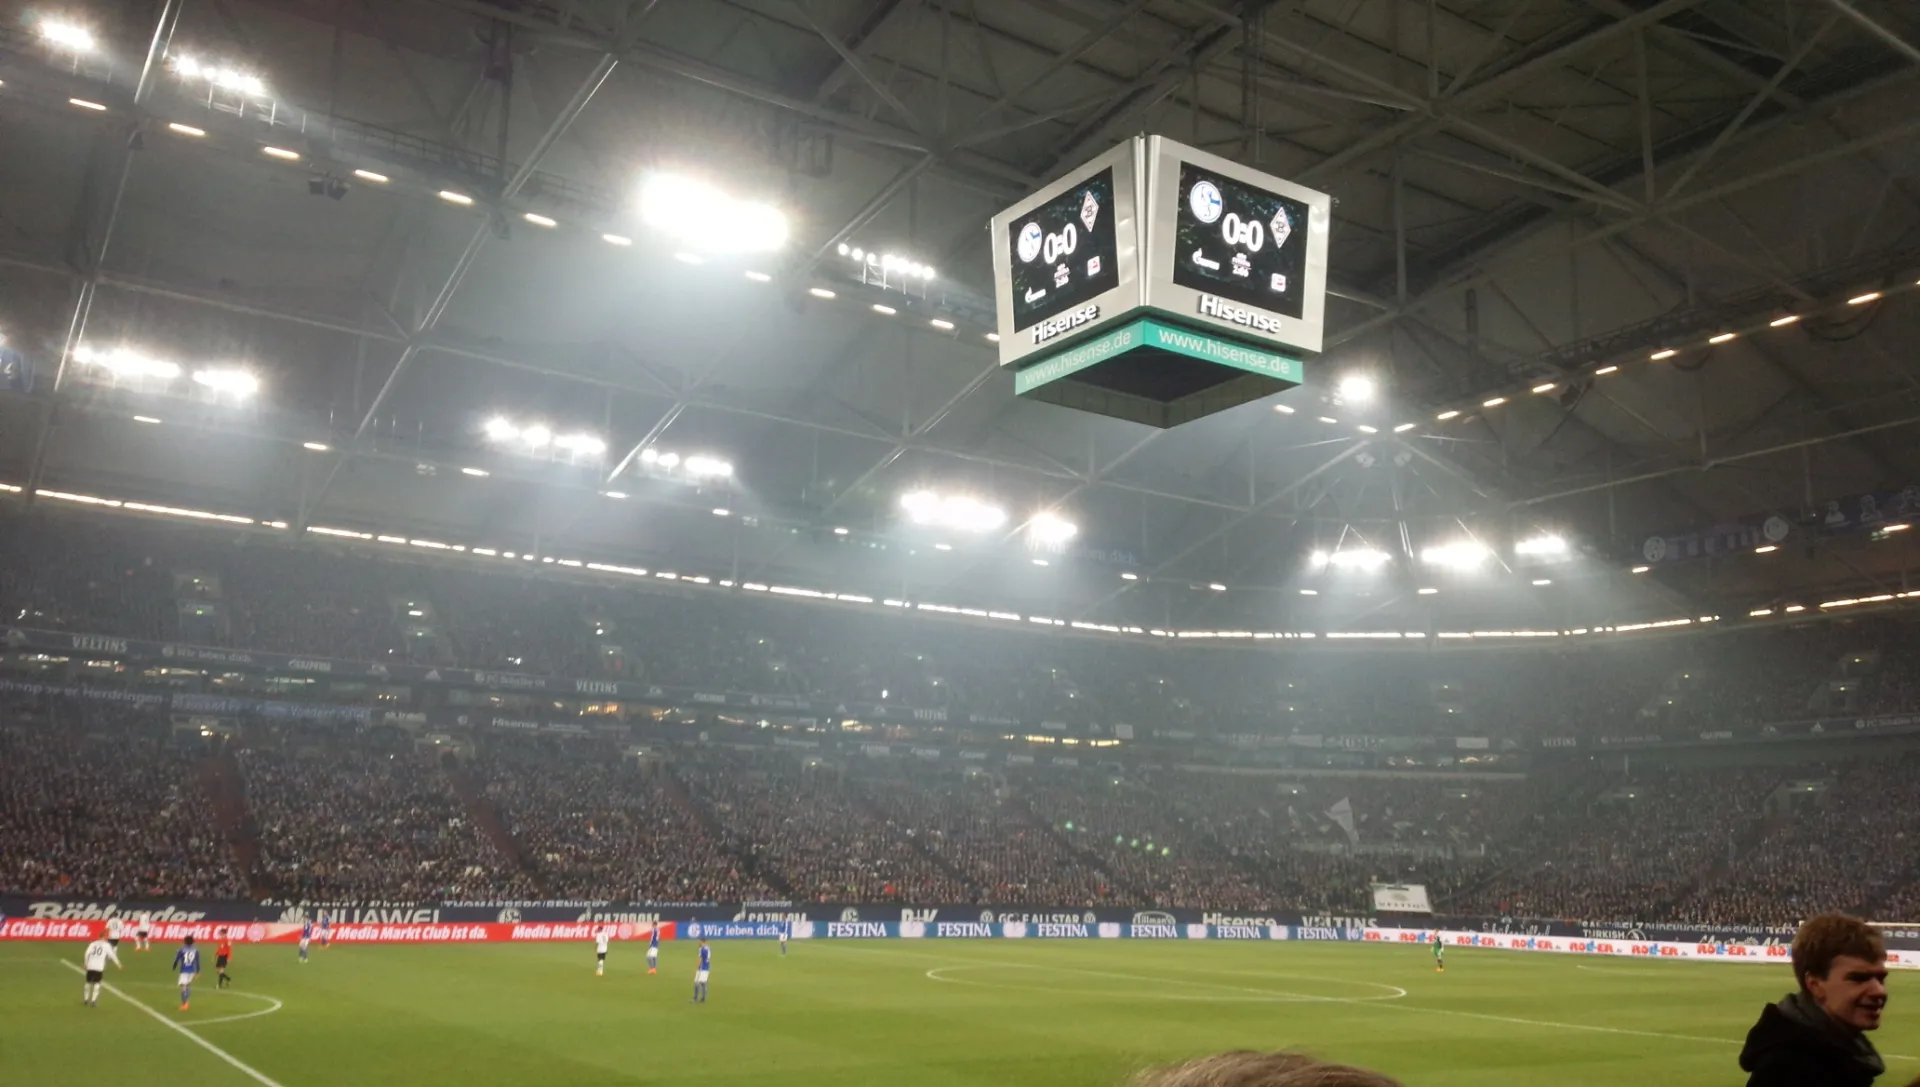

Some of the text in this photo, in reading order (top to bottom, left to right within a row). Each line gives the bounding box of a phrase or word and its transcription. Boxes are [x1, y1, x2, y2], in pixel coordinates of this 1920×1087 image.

[1222, 213, 1264, 252] 0:0
[1044, 223, 1077, 264] 0:0
[1200, 294, 1282, 333] Hisense
[1031, 304, 1098, 344] Hisense
[1025, 332, 1132, 385] www.hisense.de
[1159, 329, 1290, 374] www.hisense.de
[72, 635, 128, 653] VELTINS
[576, 680, 617, 694] VELTINS
[492, 717, 538, 730] Hisense
[316, 908, 440, 924] HUAWEI
[1202, 912, 1278, 926] Hisense
[10, 921, 45, 938] Club
[164, 923, 210, 939] Markt
[336, 925, 378, 940] Media
[380, 925, 420, 940] Markt
[422, 925, 450, 939] Club
[512, 924, 550, 939] Media
[551, 924, 590, 938] Markt
[703, 924, 722, 937] Wir
[726, 923, 754, 937] leben
[828, 922, 888, 937] FESTINA
[937, 922, 992, 937] FESTINA
[1038, 923, 1089, 937] FESTINA
[1130, 924, 1178, 938] FESTINA
[1217, 926, 1261, 938] FESTINA
[1297, 926, 1339, 939] FESTINA
